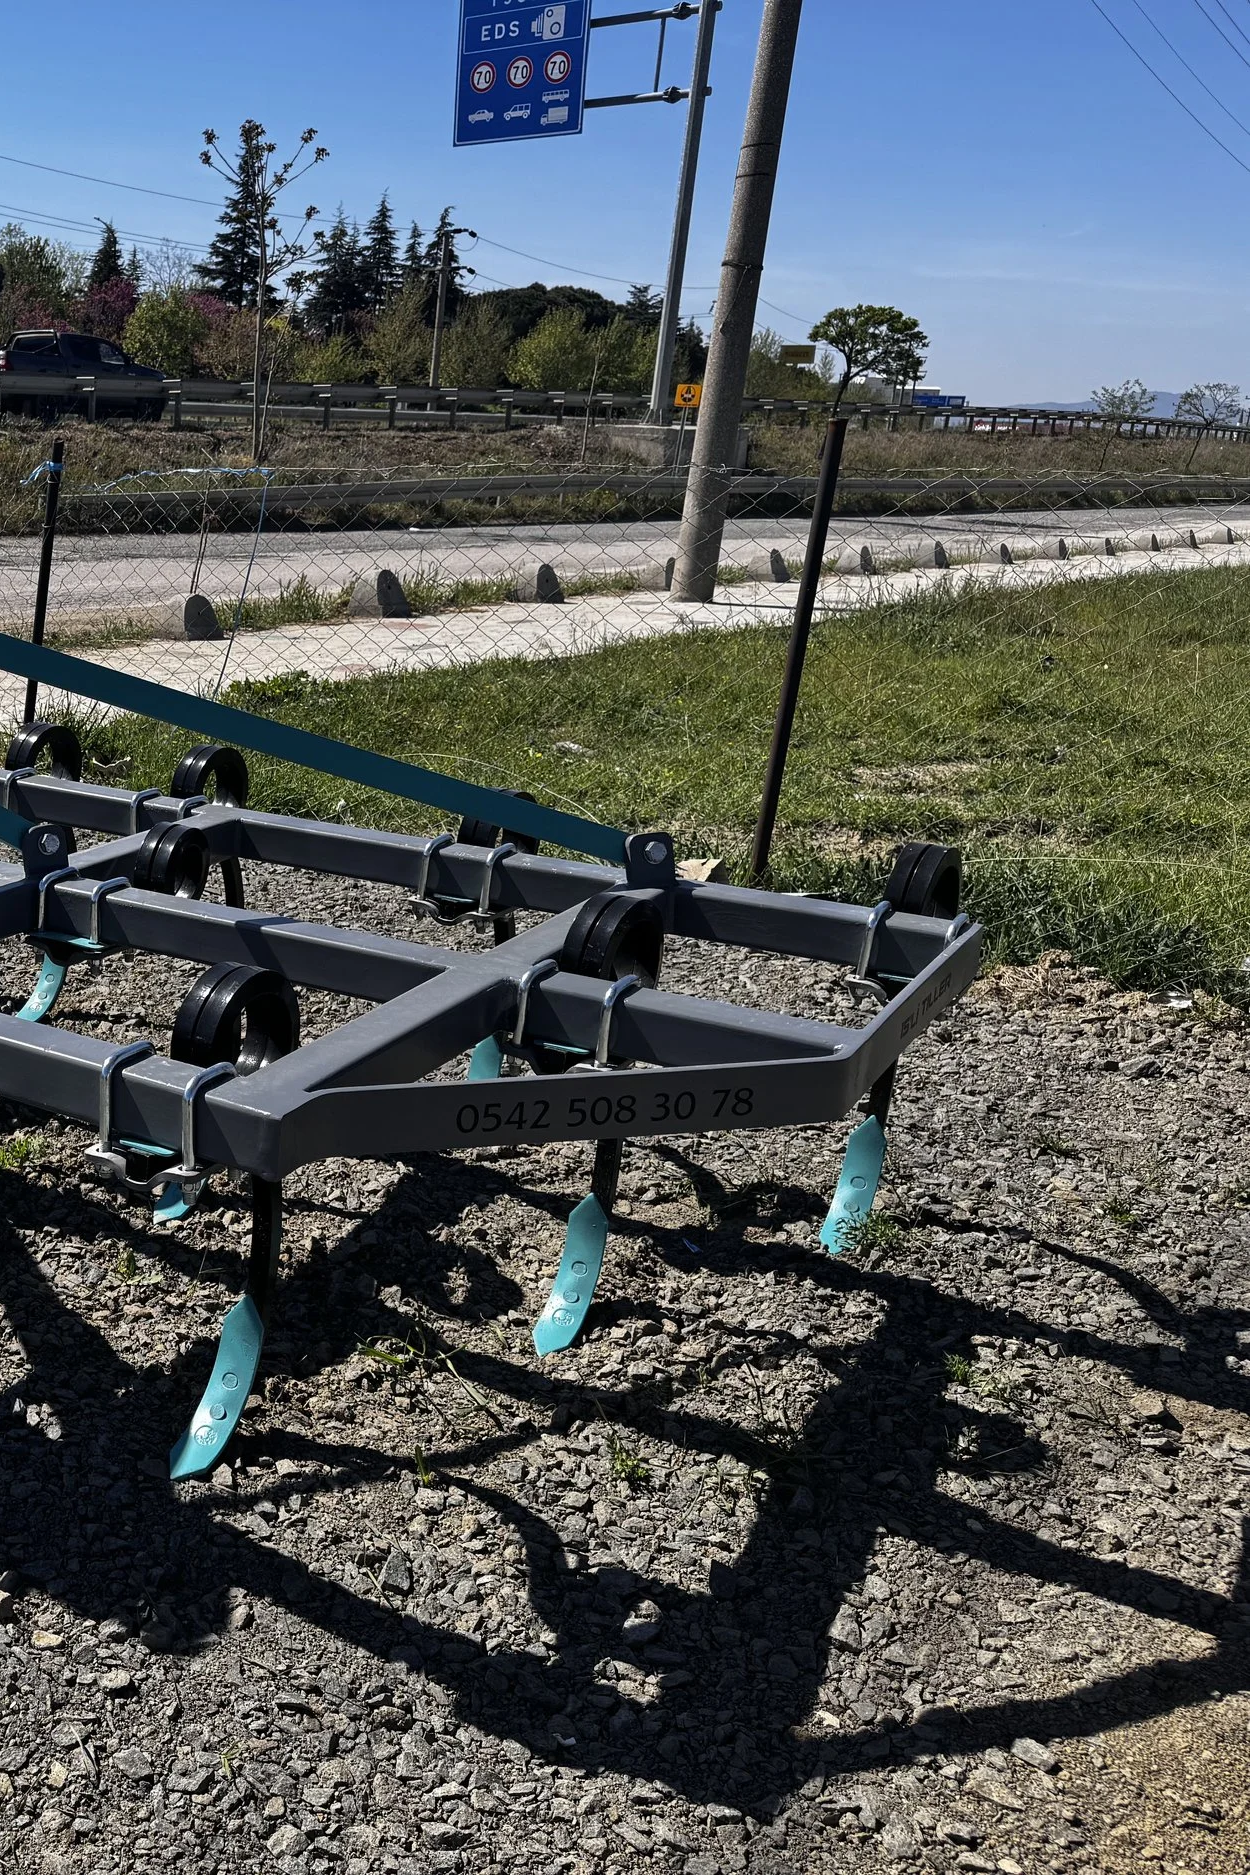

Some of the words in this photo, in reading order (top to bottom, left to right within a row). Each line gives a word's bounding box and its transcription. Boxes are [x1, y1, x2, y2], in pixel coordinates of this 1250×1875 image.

[481, 21, 520, 41] EDS
[513, 64, 529, 81] 70
[550, 59, 566, 76] 70
[476, 70, 491, 86] 70
[456, 1099, 550, 1133] 0542
[567, 1094, 637, 1127] 508
[650, 1091, 696, 1122] 30
[712, 1087, 754, 1118] 78
